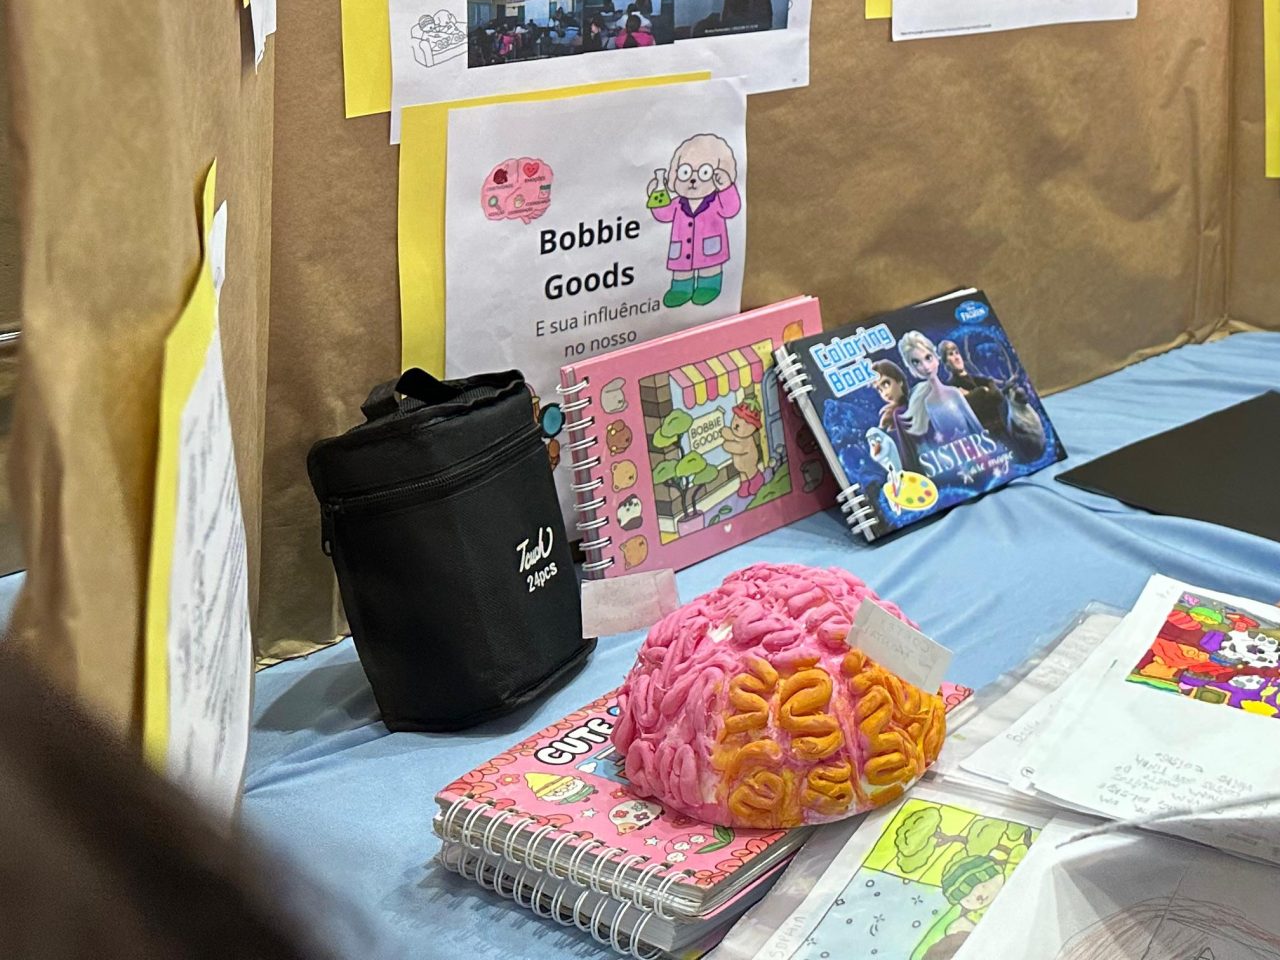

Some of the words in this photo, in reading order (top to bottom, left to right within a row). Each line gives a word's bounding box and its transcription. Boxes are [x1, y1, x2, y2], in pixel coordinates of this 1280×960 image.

[540, 217, 641, 255] Bobbie
[545, 263, 635, 300] Goods
[536, 321, 545, 336] E
[550, 316, 578, 334] sua
[583, 298, 661, 326] influência
[565, 342, 586, 357] no
[590, 330, 637, 351] nosso
[813, 326, 893, 369] Coloring
[828, 362, 877, 394] Book
[690, 416, 722, 439] BOBBIE
[693, 428, 723, 450] GOODS
[918, 429, 998, 477] SISTERS
[526, 562, 558, 593] 24pcs
[534, 717, 614, 766] CUTE
